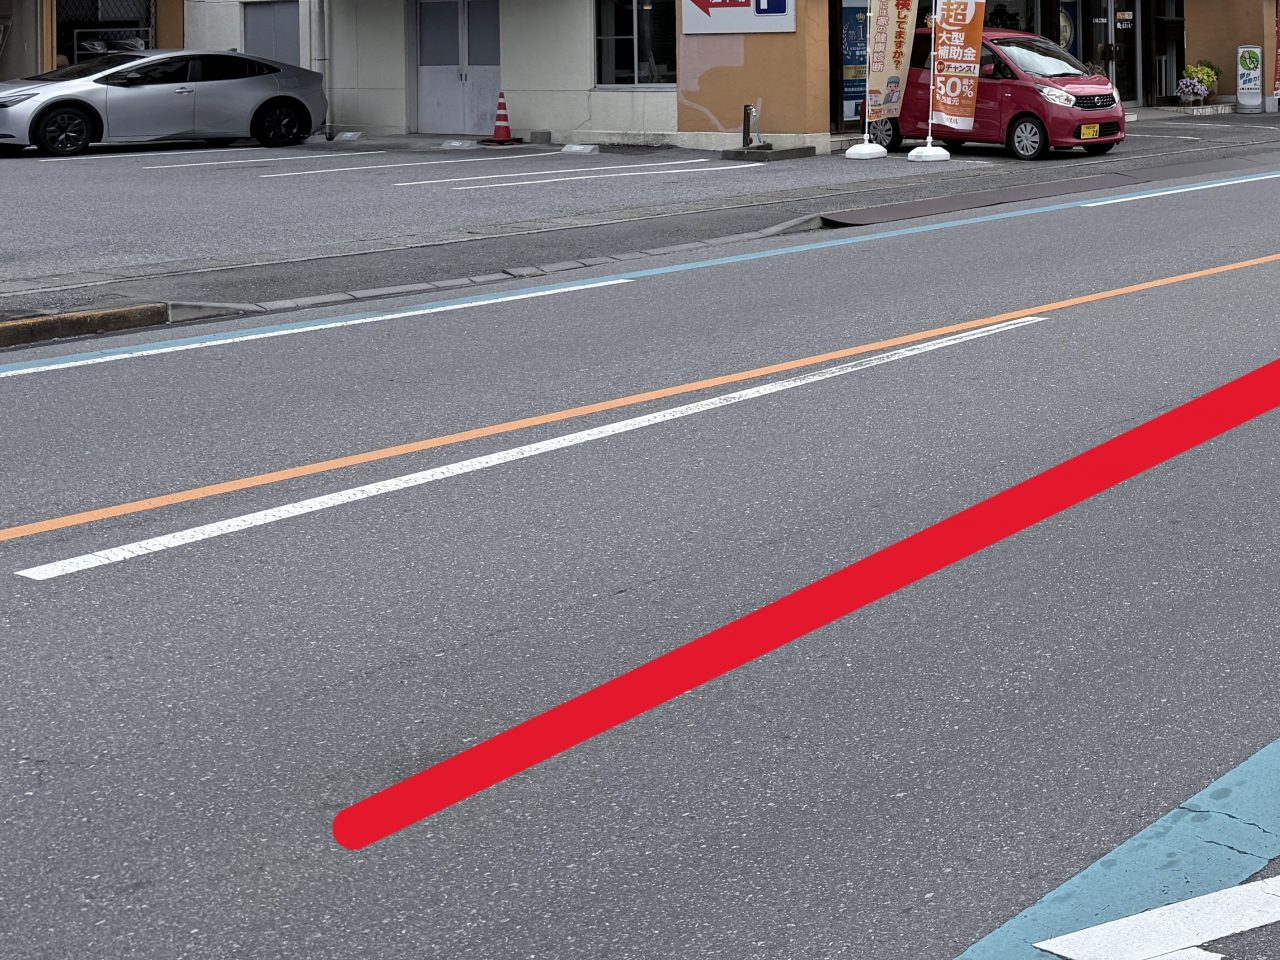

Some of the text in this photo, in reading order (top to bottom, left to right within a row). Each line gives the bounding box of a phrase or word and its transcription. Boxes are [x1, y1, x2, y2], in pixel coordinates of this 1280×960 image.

[941, 0, 969, 24] 超
[938, 31, 965, 46] 大型
[937, 45, 976, 61] 補助金
